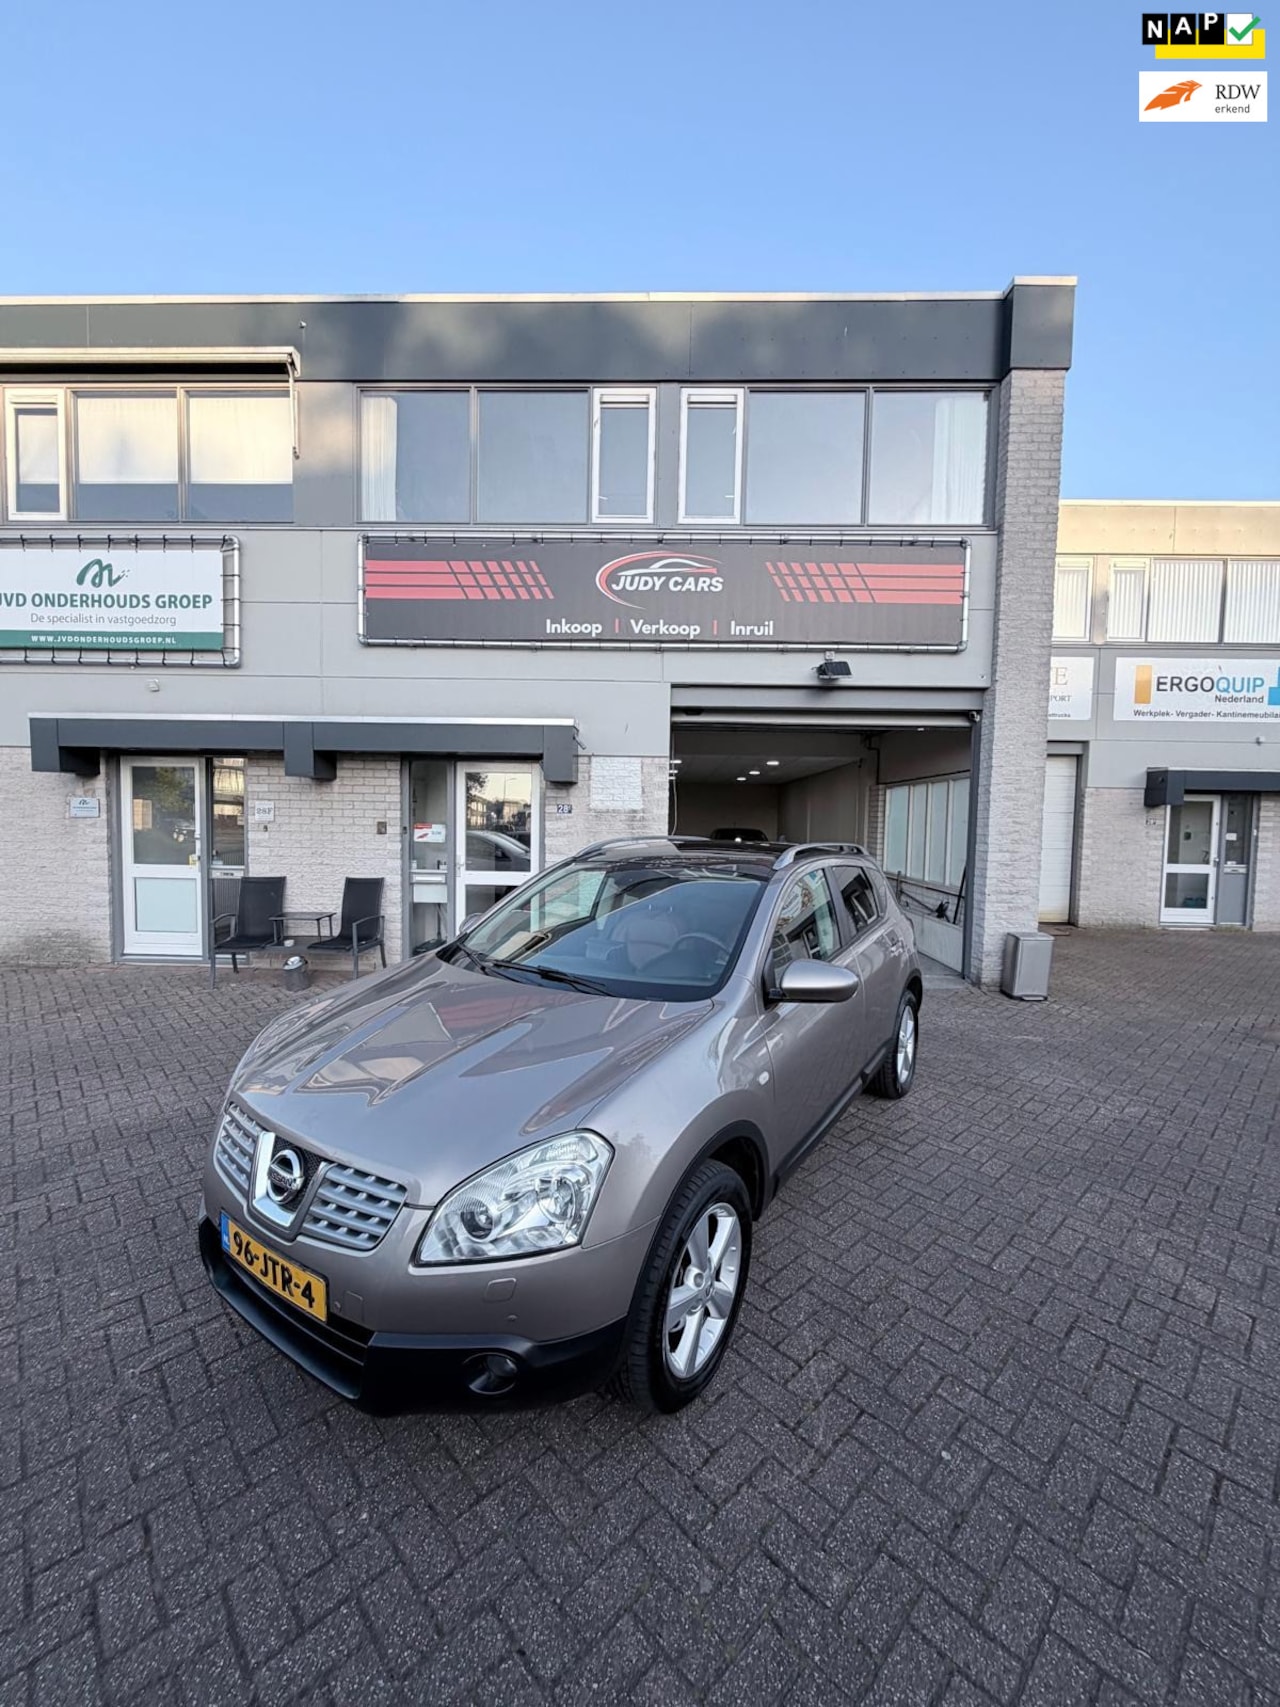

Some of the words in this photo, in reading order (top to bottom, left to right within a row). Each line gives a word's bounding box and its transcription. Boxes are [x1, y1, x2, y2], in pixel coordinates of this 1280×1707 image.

[611, 574, 665, 592] JUDY
[668, 575, 724, 593] CARS
[31, 592, 151, 609] ONDERHOUDS
[155, 593, 213, 609] GROEP
[31, 613, 45, 623] De
[47, 613, 93, 626] specialist
[95, 614, 105, 624] in
[108, 613, 177, 627] vastgoedzorg
[545, 619, 603, 638] Inkoop
[630, 620, 701, 639] Verkoop
[730, 620, 774, 636] Inruil
[1156, 675, 1265, 694] ERGOQUIP
[1215, 694, 1265, 704] Nederland
[233, 1230, 315, 1309] 96-JTR-4
